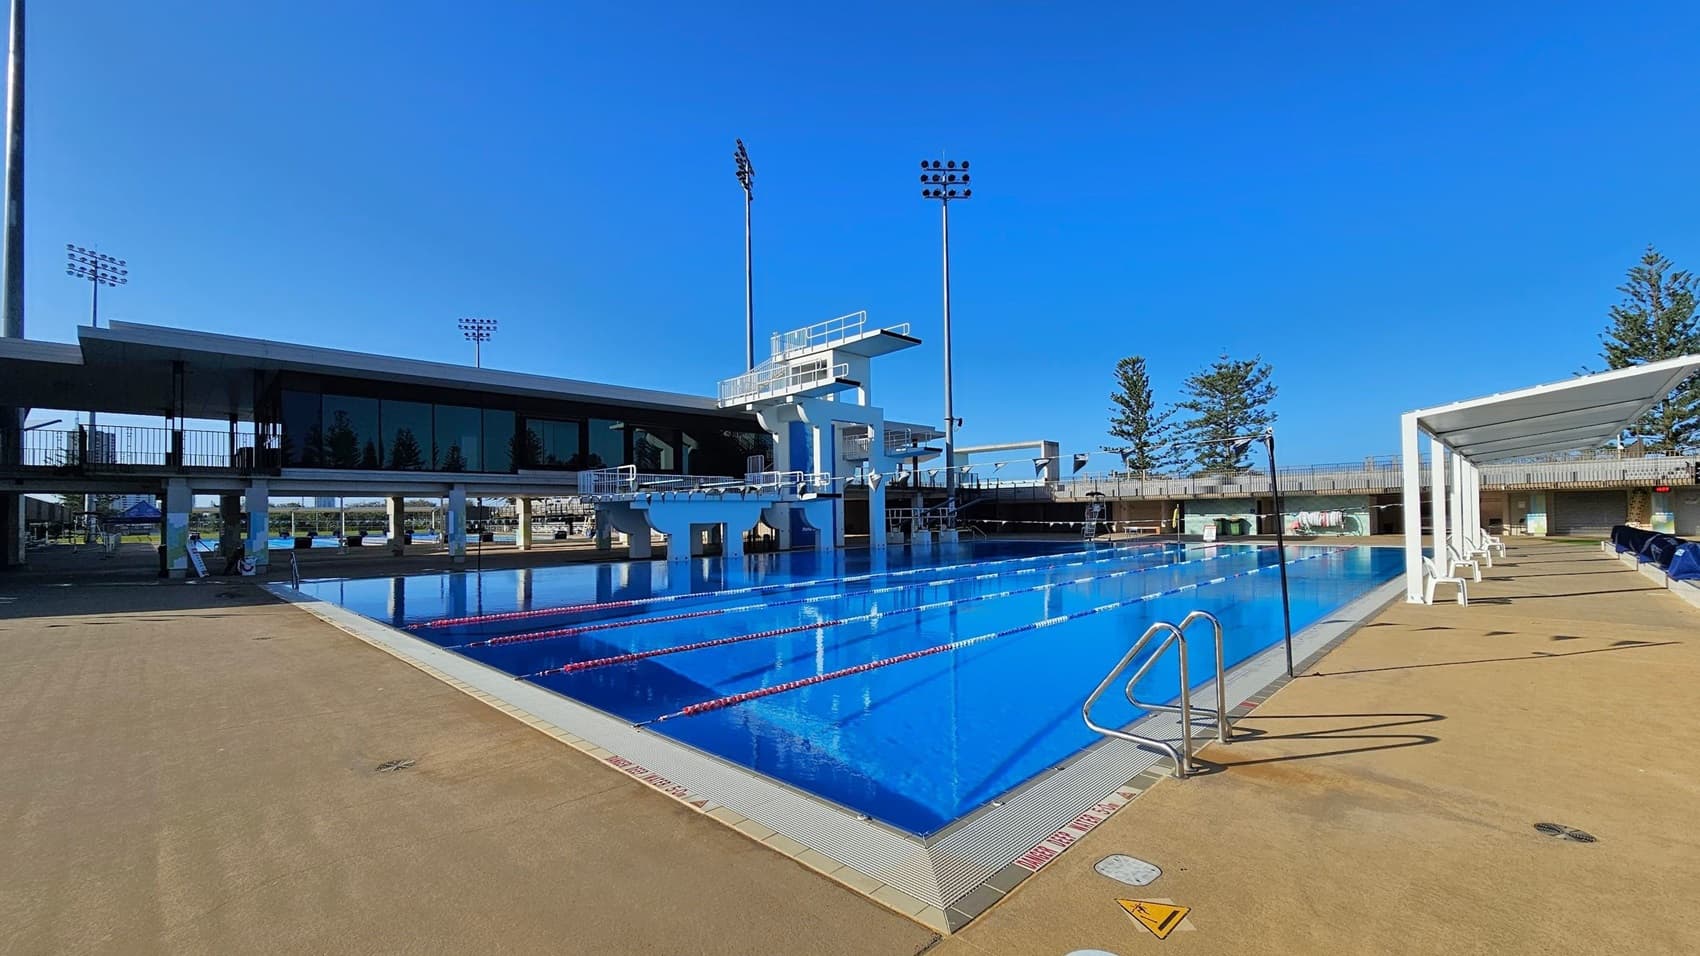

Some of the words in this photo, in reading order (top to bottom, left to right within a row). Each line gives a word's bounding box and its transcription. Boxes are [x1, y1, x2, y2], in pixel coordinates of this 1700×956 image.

[1014, 846, 1058, 869] DANGER
[1046, 831, 1077, 848] DEEP
[1068, 814, 1102, 832] WATER
